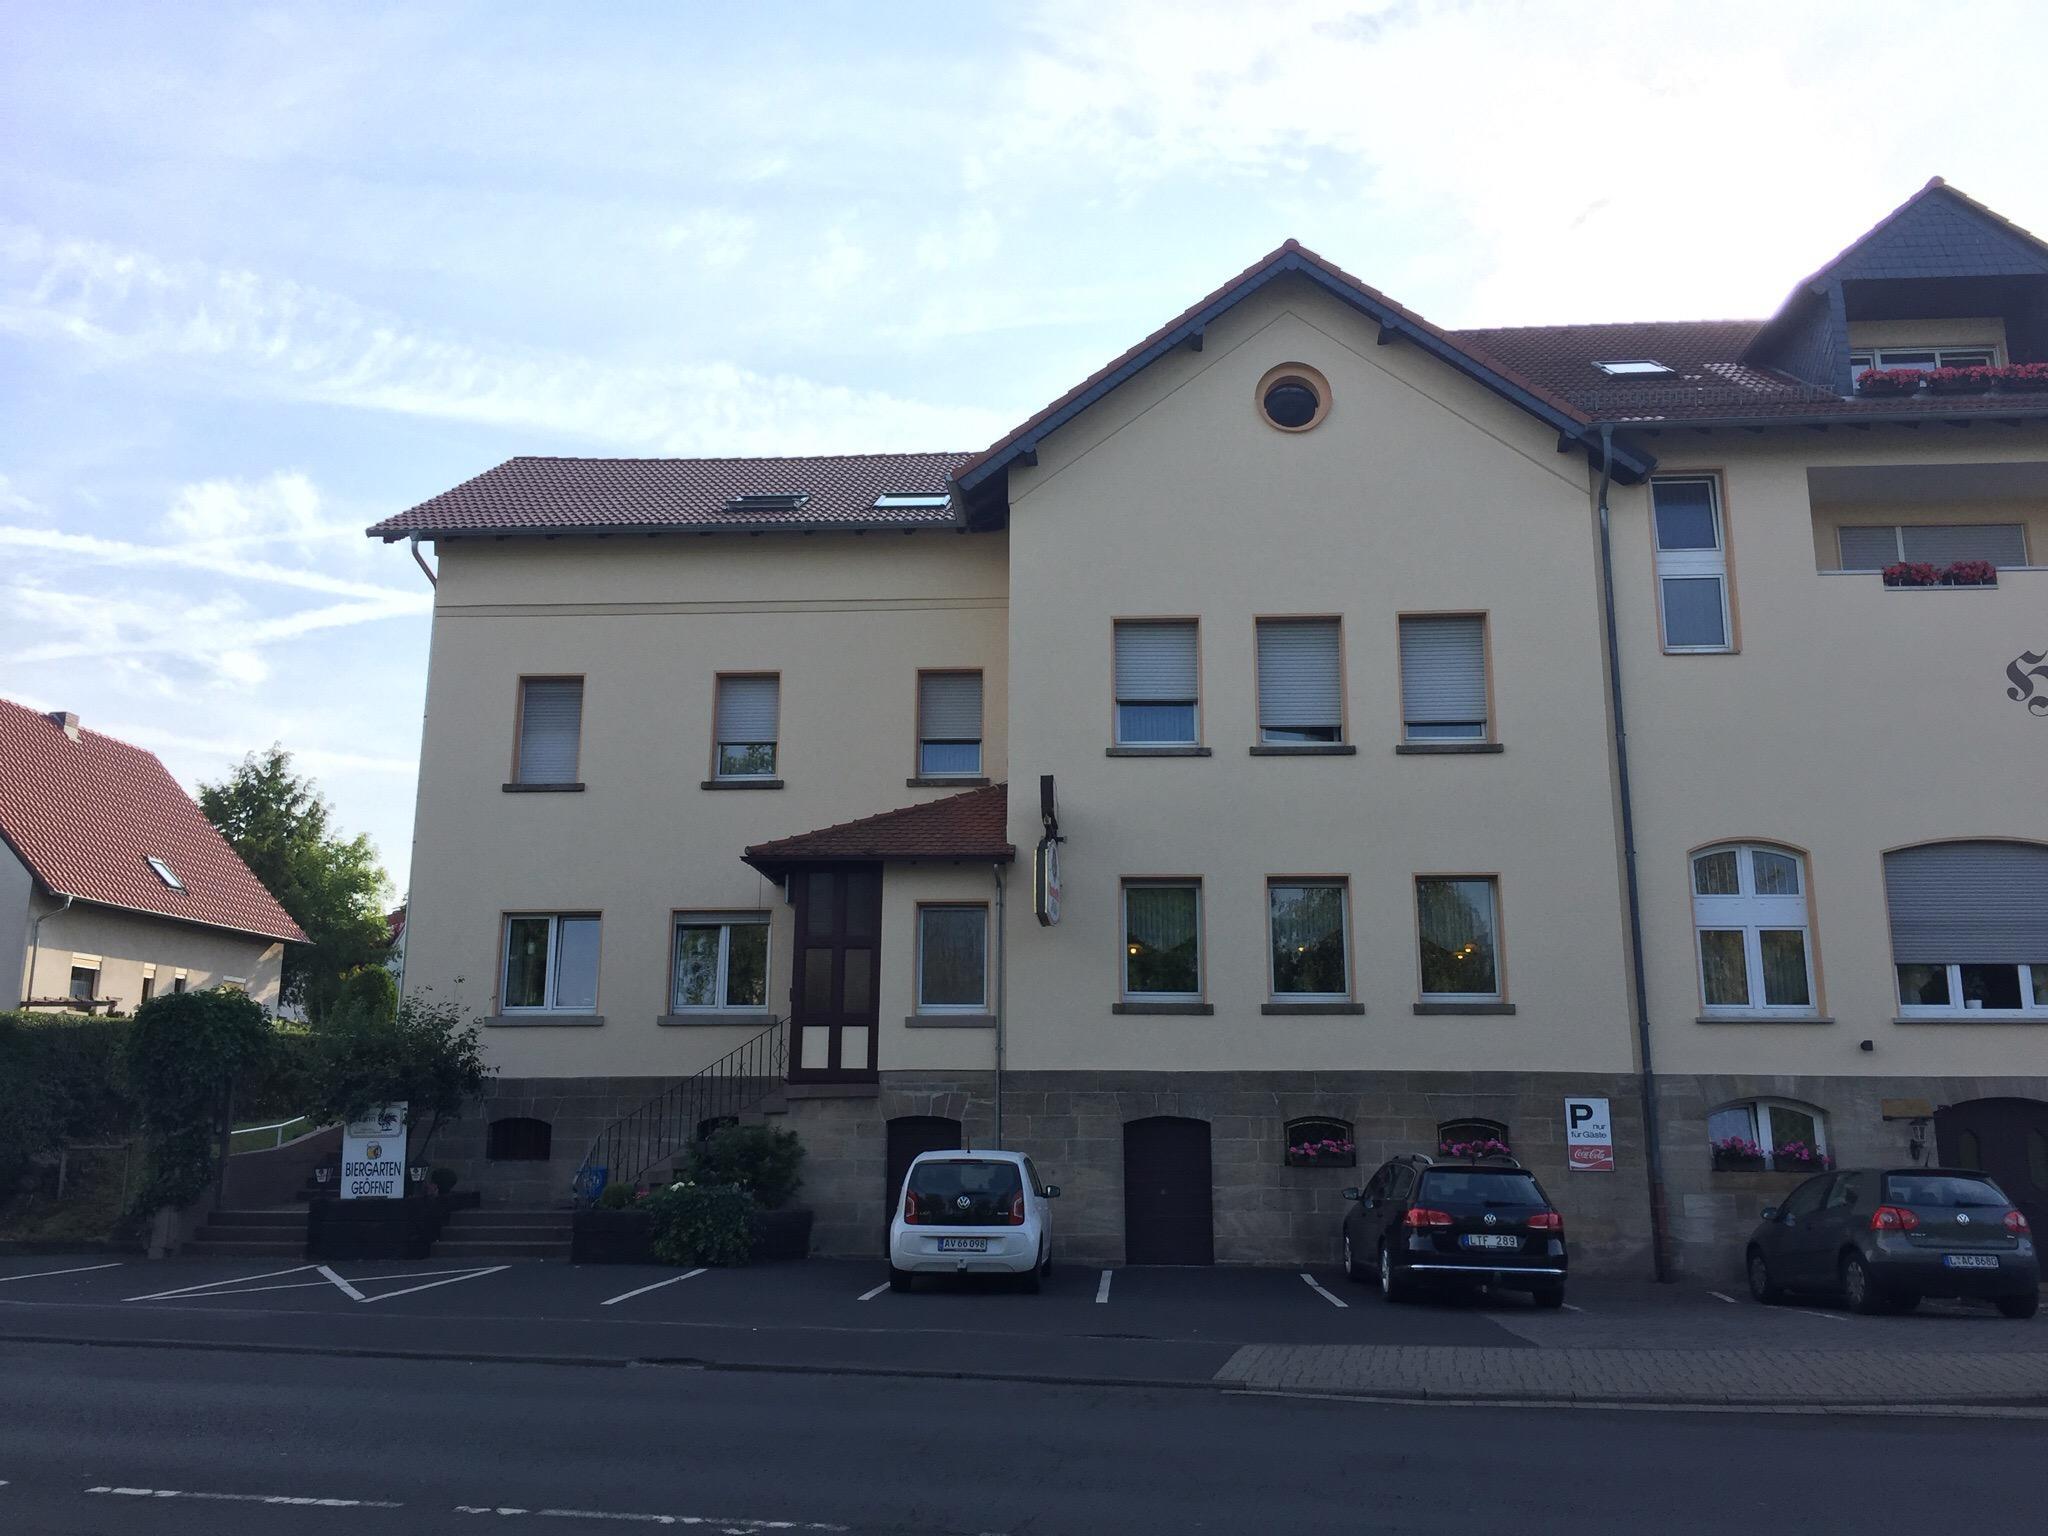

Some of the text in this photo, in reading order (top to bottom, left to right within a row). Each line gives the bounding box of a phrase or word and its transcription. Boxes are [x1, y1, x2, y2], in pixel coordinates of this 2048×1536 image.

[1570, 1104, 1593, 1129] P
[1571, 1130, 1582, 1138] für
[345, 1161, 402, 1177] BIERGARTEN
[351, 1178, 394, 1195] GEÖFFNET
[944, 1239, 985, 1248] AV 66 098
[1496, 1236, 1515, 1246] 289
